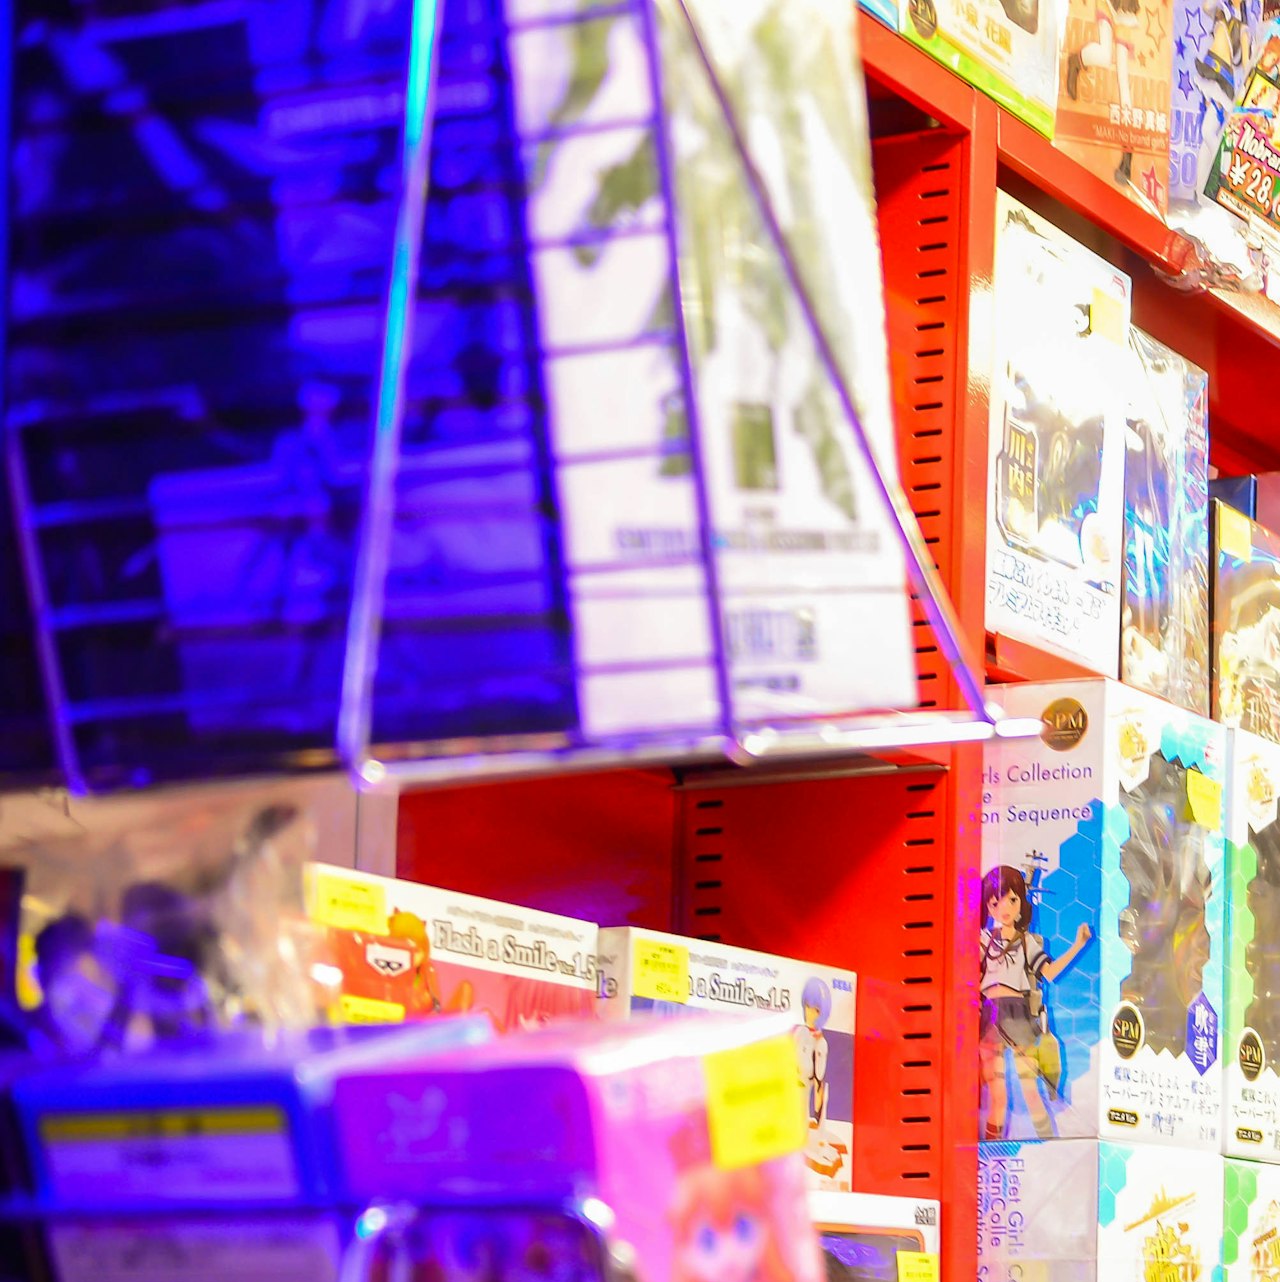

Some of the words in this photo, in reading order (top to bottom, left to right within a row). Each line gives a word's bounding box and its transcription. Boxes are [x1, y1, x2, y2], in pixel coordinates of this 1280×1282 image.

[1007, 763, 1093, 783] Collection
[1007, 805, 1092, 826] Sequence
[433, 919, 484, 958] Flash
[487, 939, 500, 961] a
[502, 934, 557, 971] Smile
[709, 973, 755, 1006] Smile
[1113, 1019, 1140, 1041] SPM
[1239, 1043, 1262, 1064] SPM
[1007, 1158, 1025, 1204] Fleet
[989, 1158, 1008, 1248] KanColle
[1007, 1211, 1025, 1256] Girls
